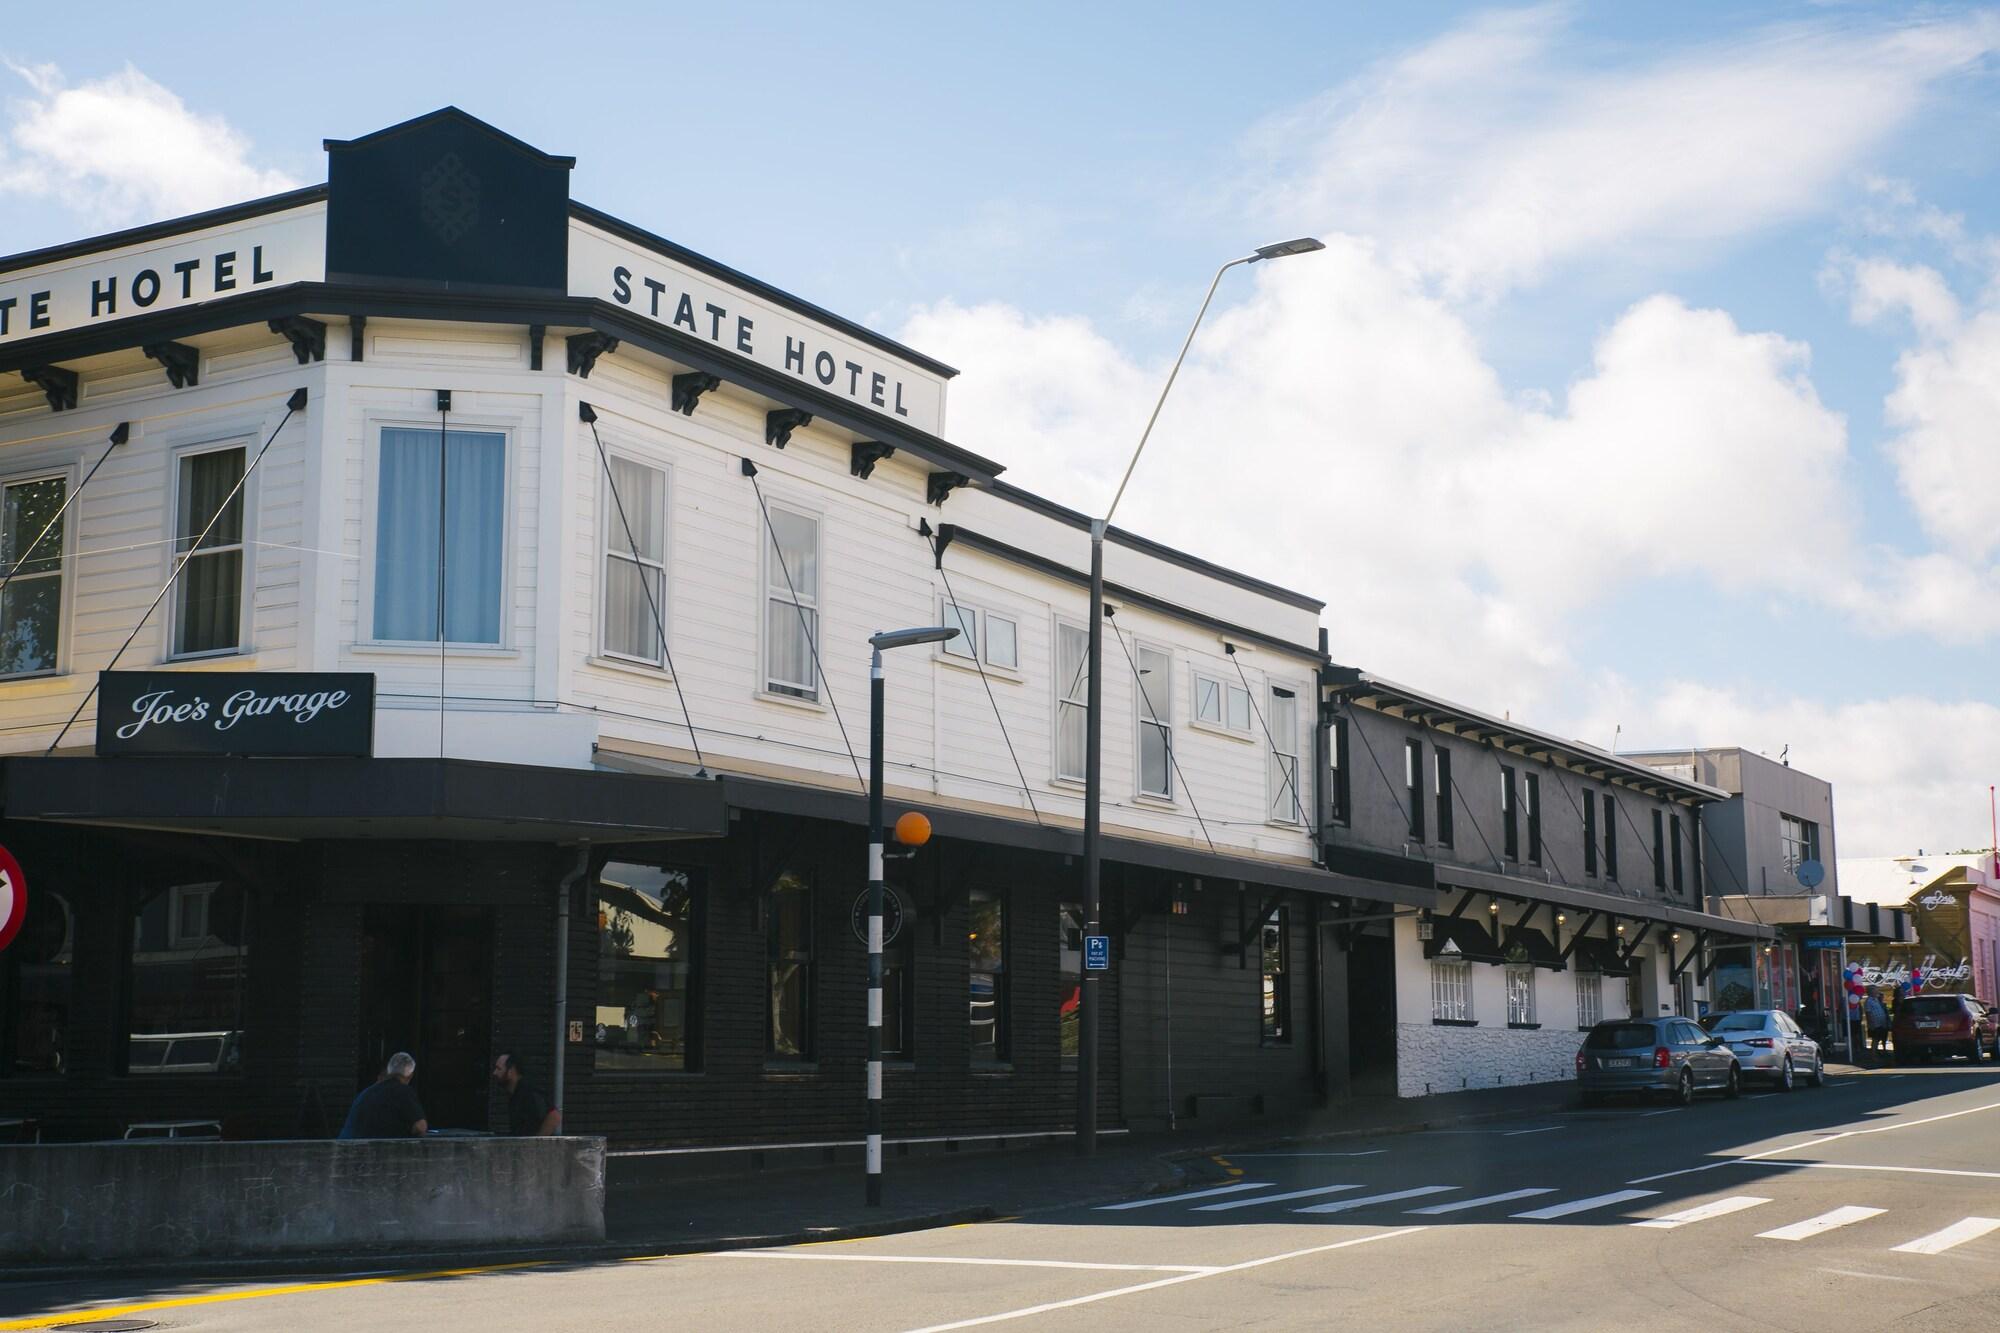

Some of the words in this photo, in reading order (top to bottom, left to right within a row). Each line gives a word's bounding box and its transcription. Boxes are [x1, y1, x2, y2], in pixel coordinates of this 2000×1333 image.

[91, 246, 274, 318] HOTEL
[612, 265, 754, 354] STATE
[785, 336, 908, 417] HOTEL
[116, 689, 208, 739] Joe's
[215, 688, 351, 731] Garage
